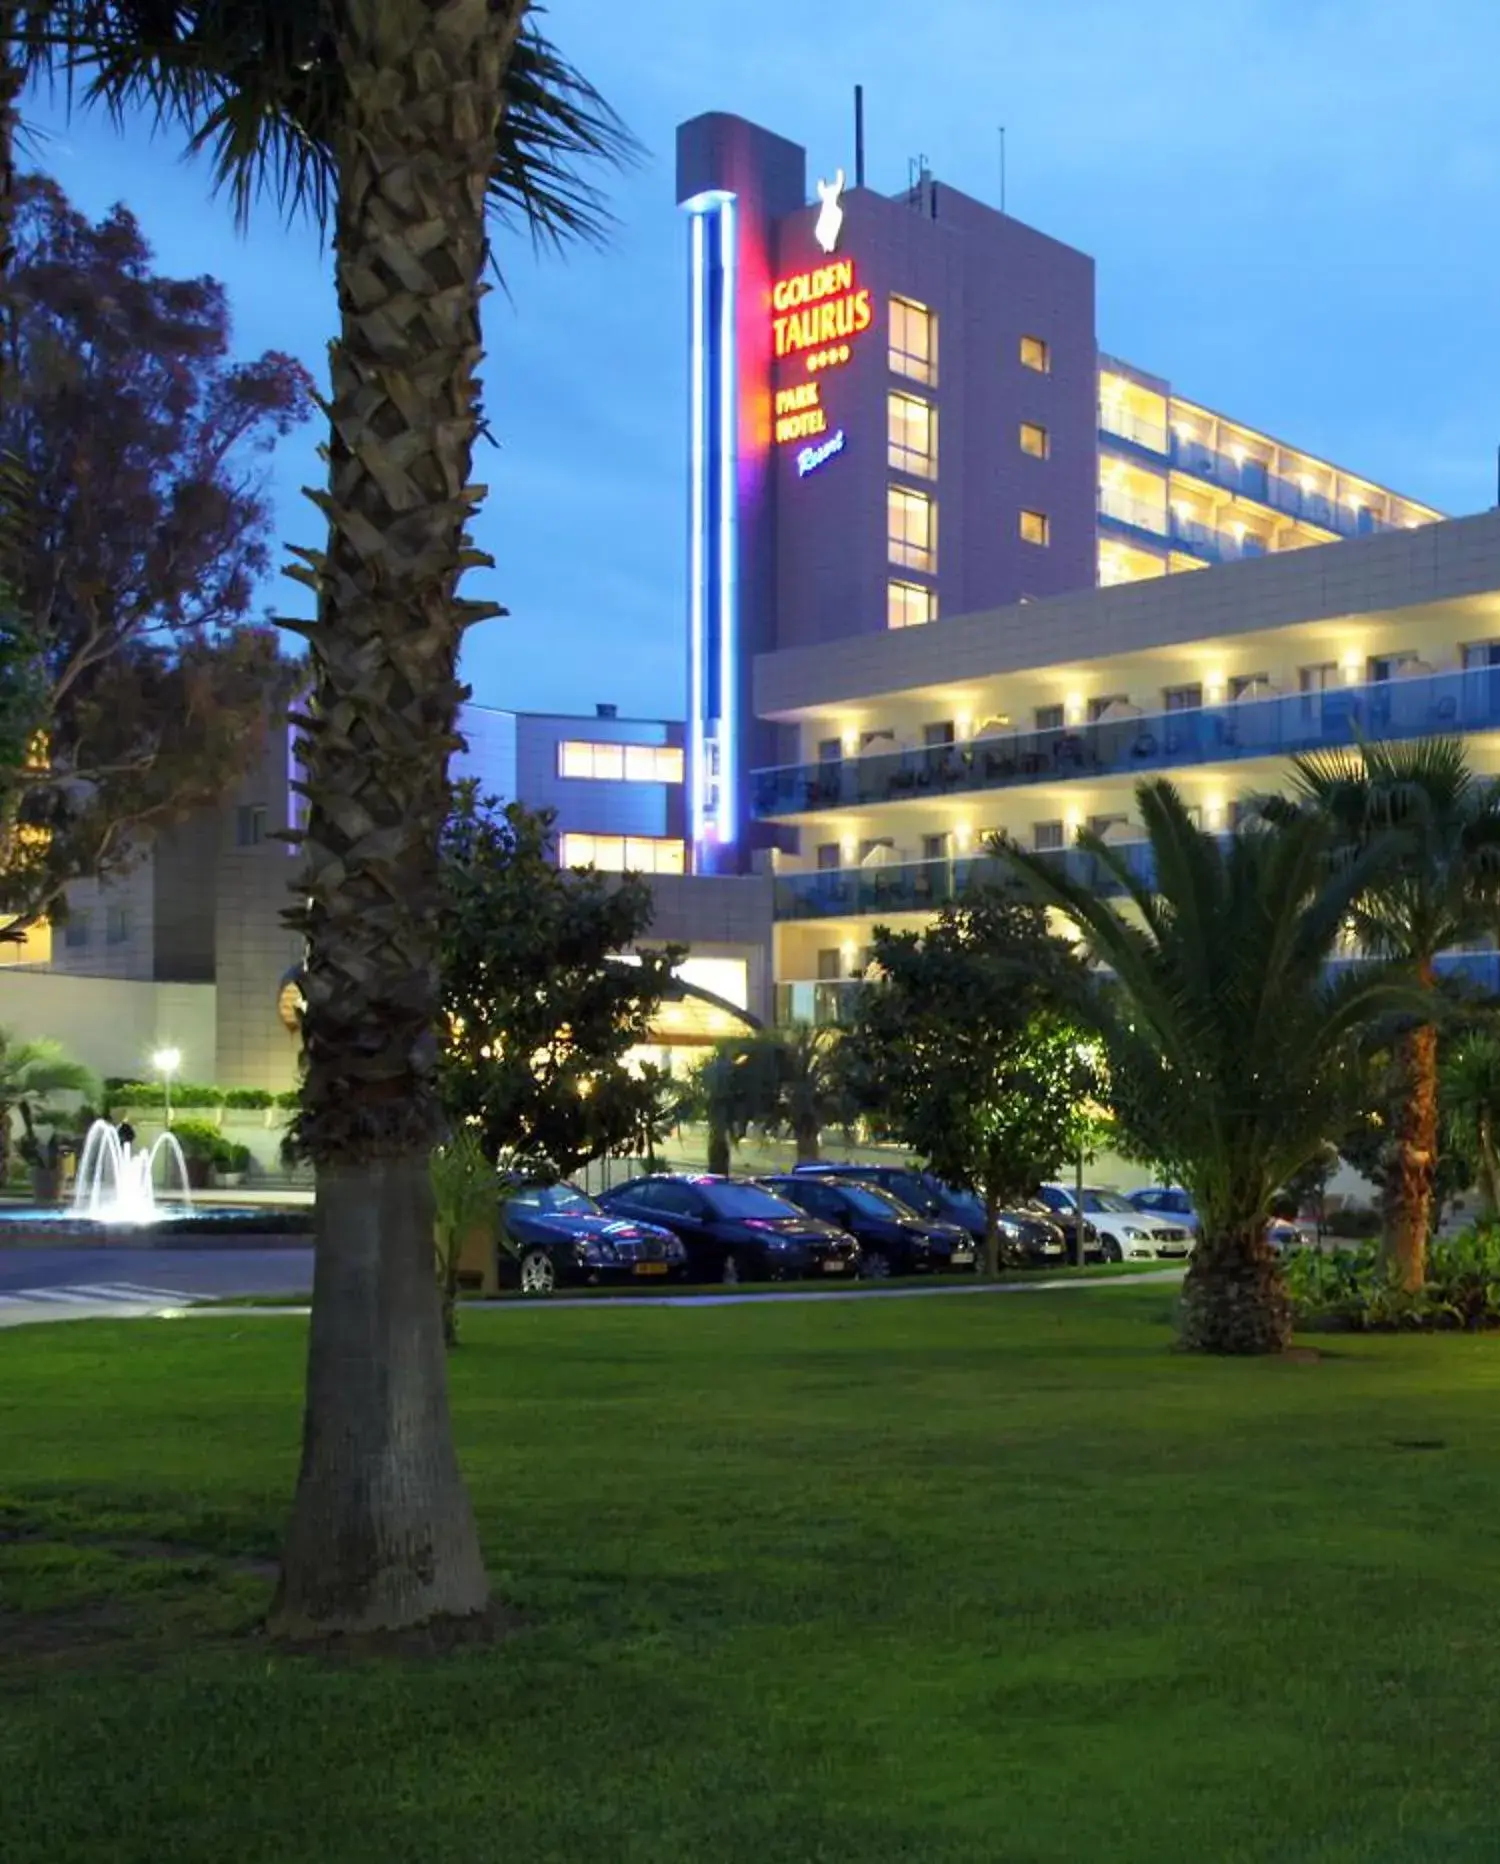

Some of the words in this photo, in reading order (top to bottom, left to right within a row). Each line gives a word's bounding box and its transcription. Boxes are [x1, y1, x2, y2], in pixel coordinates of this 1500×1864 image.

[774, 261, 852, 311] GOLDEN
[773, 290, 871, 356] TAURUS
[776, 382, 818, 414] PARK
[776, 408, 827, 443] HOTEL
